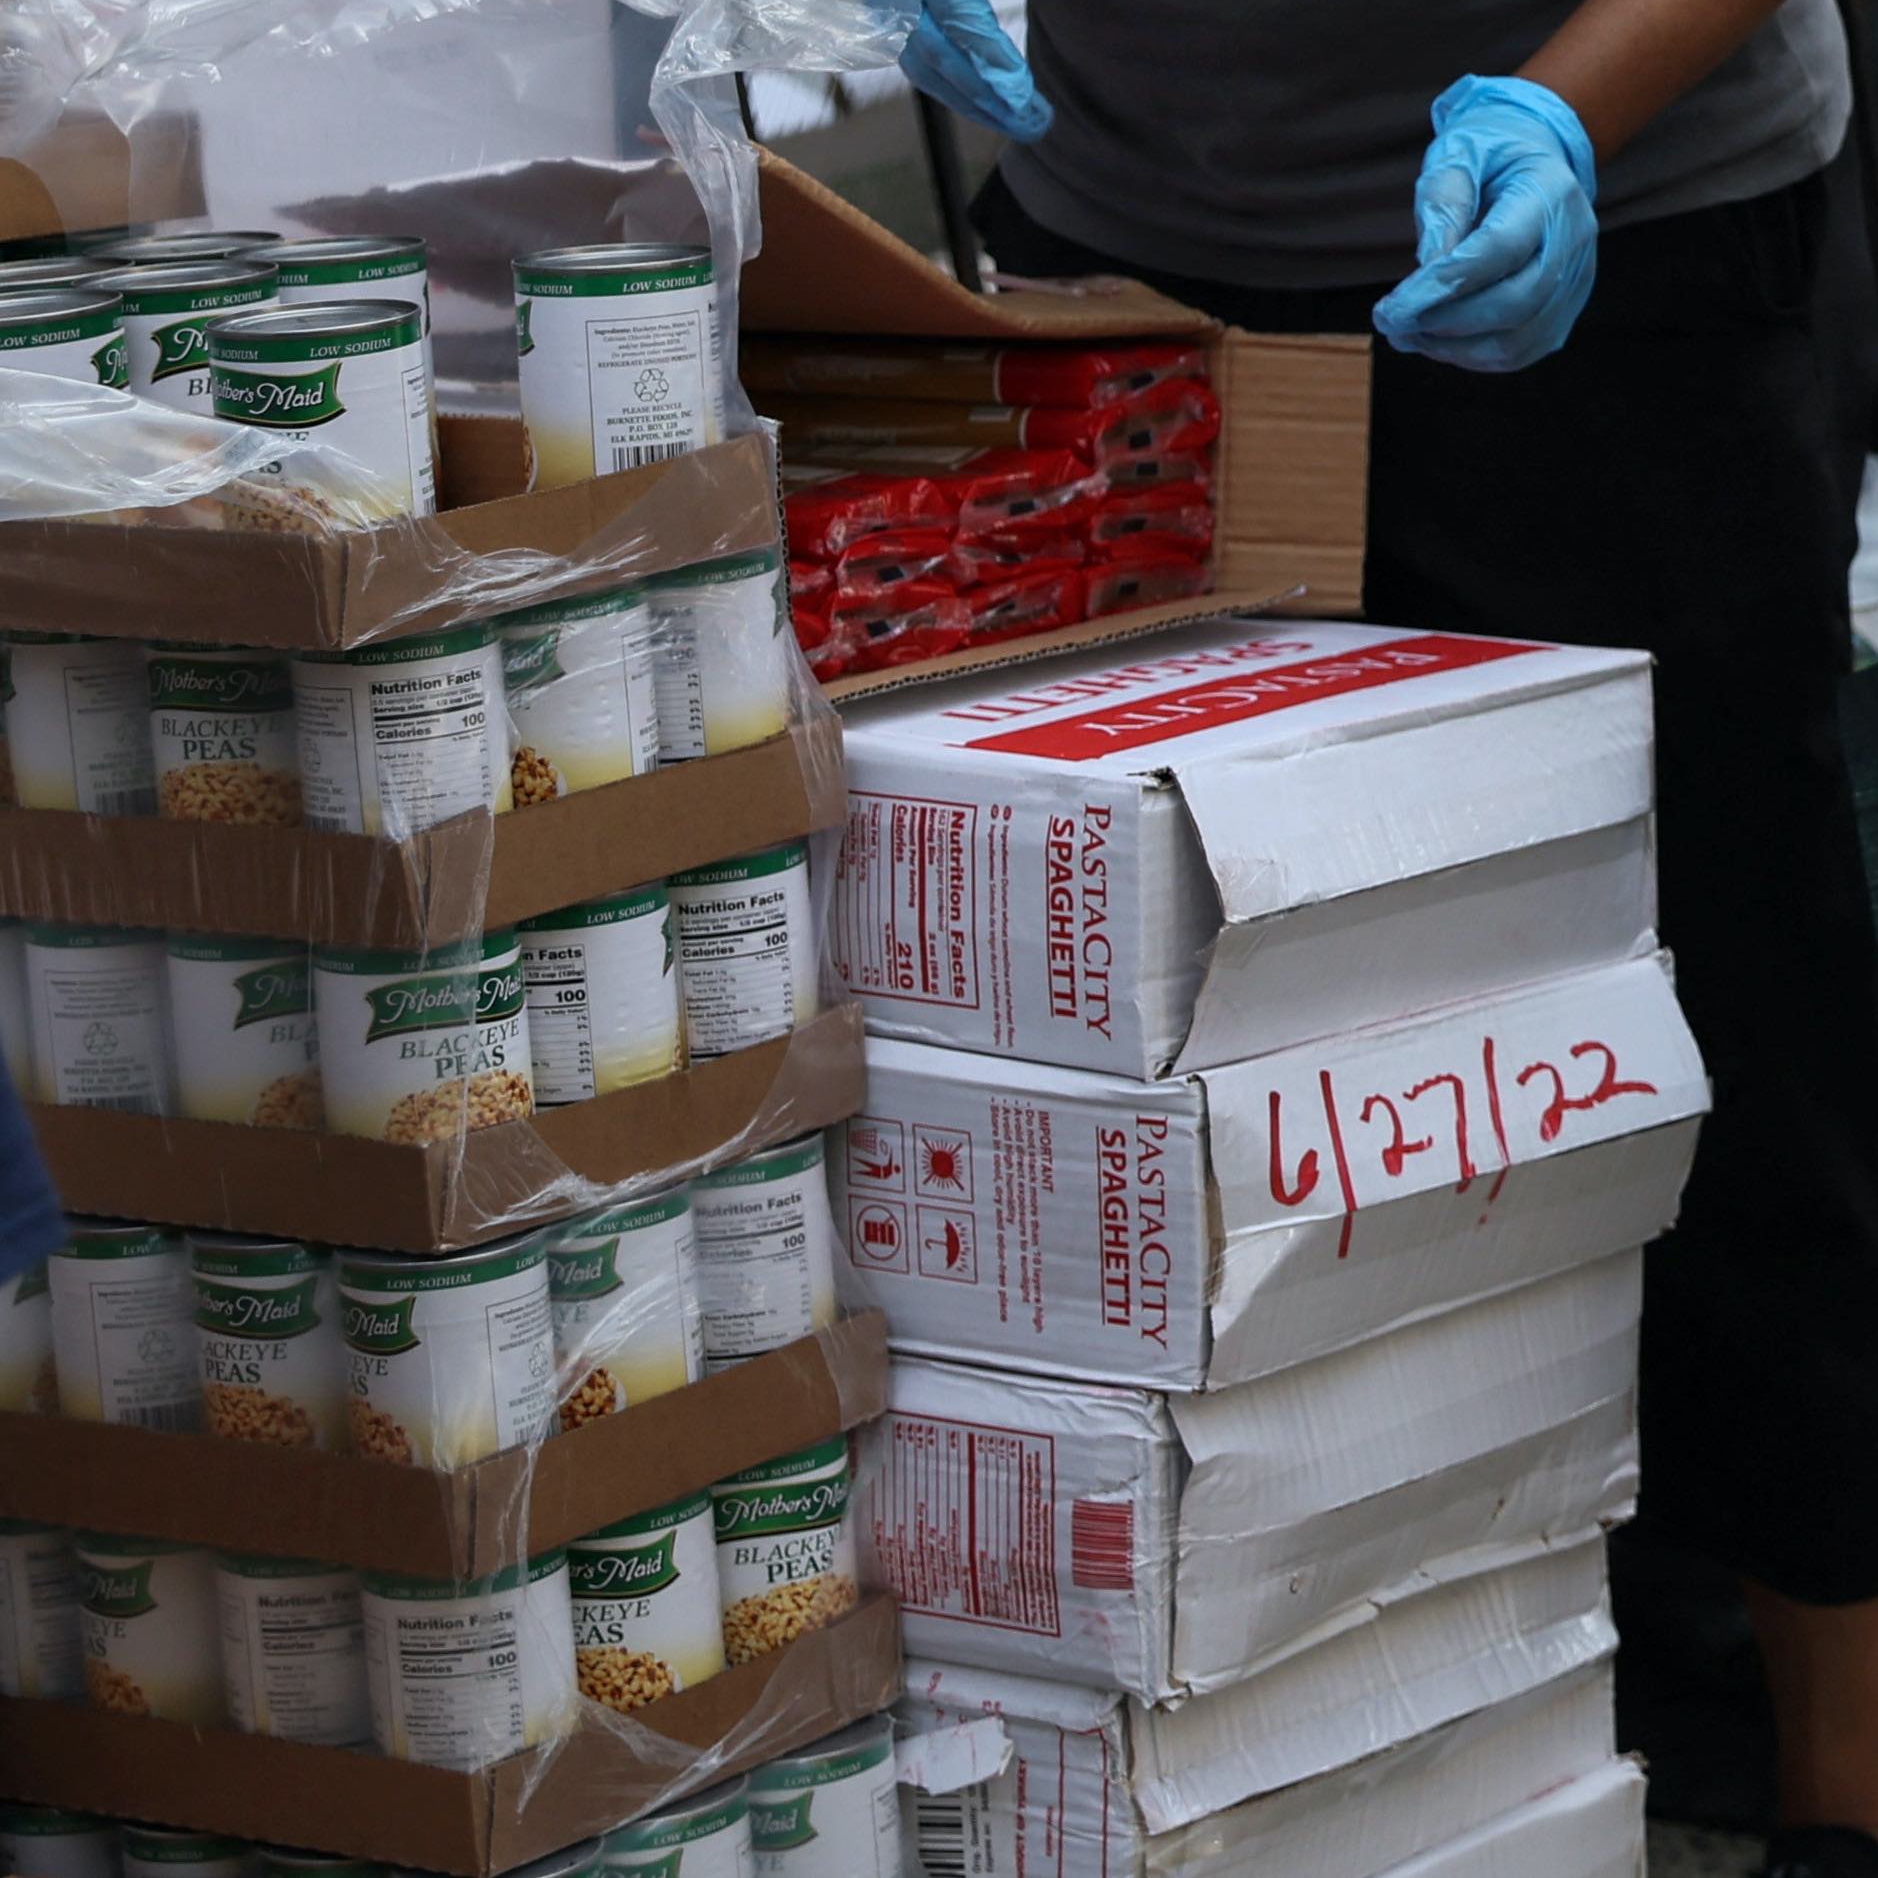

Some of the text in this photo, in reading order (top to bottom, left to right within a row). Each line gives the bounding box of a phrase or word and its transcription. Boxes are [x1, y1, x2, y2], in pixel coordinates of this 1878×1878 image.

[358, 266, 385, 279] LOW
[623, 275, 697, 293] LOW SODIUM
[191, 290, 263, 310] LOW SODIUM
[533, 284, 573, 295] SODIUM
[31, 328, 81, 344] SODIUM
[310, 338, 392, 358] LOW SODIUM
[221, 349, 259, 361] SODIUM
[213, 375, 326, 415] other's Maid
[622, 406, 650, 415] PLEASE
[359, 644, 445, 663] LOW SODIUM
[371, 669, 483, 696] Nutrition Facts
[940, 638, 1314, 723] SPAGHETTI
[1082, 650, 1443, 738] PASTACITY
[461, 711, 486, 728] 100
[376, 726, 432, 741] Calories
[183, 737, 256, 760] PEAS
[895, 804, 907, 863] Calories
[927, 807, 937, 843] Serving
[699, 868, 748, 883] SODIUM
[678, 891, 785, 916] Nutrition Facts
[950, 810, 967, 999] Nutrition Facts
[1000, 878, 1011, 909] Durum
[587, 900, 656, 924] LOW SODIUM
[1050, 818, 1078, 1018] SPAGHETTI
[1081, 803, 1114, 1042] PASTACITY
[765, 931, 788, 947] 100
[539, 947, 582, 961] Facts
[682, 946, 735, 958] Calories
[898, 942, 914, 990] 210
[555, 989, 586, 1003] 100
[435, 1044, 505, 1079] PEAS
[990, 1105, 1000, 1137] Store
[1025, 1109, 1035, 1127] Do
[992, 1139, 1002, 1150] in
[1026, 1128, 1036, 1148] not
[1268, 1035, 1659, 1258] 6/27/22
[1037, 1110, 1054, 1194] IMPORTANT
[1001, 1106, 1016, 1226] Avoid high humidity
[1028, 1151, 1038, 1182] stack
[696, 1192, 803, 1219] Nutrition Facts
[993, 1186, 1004, 1205] dry
[1013, 1108, 1031, 1303] Avoid direct exposure to sunlight
[1030, 1186, 1039, 1215] more
[590, 1209, 666, 1234] LOW SODIUM
[996, 1209, 1006, 1230] and
[1100, 1128, 1132, 1328] SPAGHETTI
[1135, 1113, 1173, 1350] PASTACITY
[781, 1233, 806, 1250] 100
[1030, 1219, 1041, 1246] than
[387, 1278, 415, 1290] LOW
[418, 1273, 472, 1289] SODIUM
[1031, 1267, 1043, 1304] layers
[228, 1295, 301, 1327] Maid
[997, 1290, 1010, 1323] place
[346, 1306, 400, 1337] Maid
[1033, 1306, 1045, 1333] high
[205, 1341, 288, 1361] ACKEYE
[205, 1362, 262, 1384] PEAS
[650, 1515, 678, 1530] LOW
[716, 1492, 812, 1531] Mother's
[588, 1550, 663, 1590] Maid
[766, 1549, 834, 1584] PEAS
[573, 1599, 651, 1622] CKEYE
[398, 1616, 465, 1631] Nutrition
[574, 1622, 625, 1646] EAS
[402, 1663, 453, 1674] Calories
[488, 1650, 517, 1667] 100
